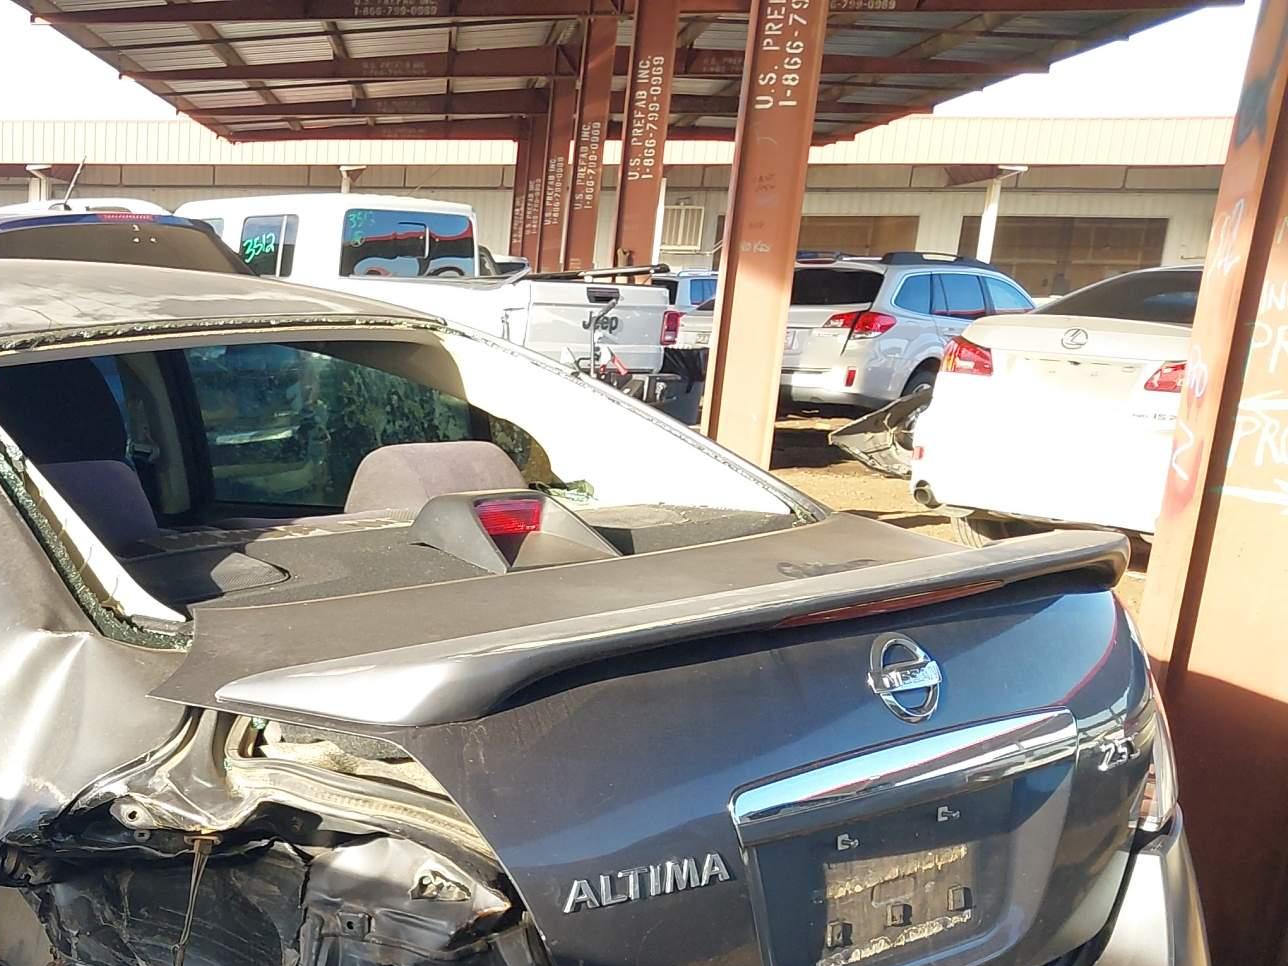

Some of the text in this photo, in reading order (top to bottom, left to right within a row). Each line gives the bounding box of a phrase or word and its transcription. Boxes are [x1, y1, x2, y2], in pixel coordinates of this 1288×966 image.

[754, 0, 787, 110] U.S. PRE
[627, 55, 652, 180] U.S. PREFAB INC.
[641, 56, 665, 179] 1-866-799-0969
[242, 232, 276, 264] 3512
[563, 851, 730, 914] ALTIMA
